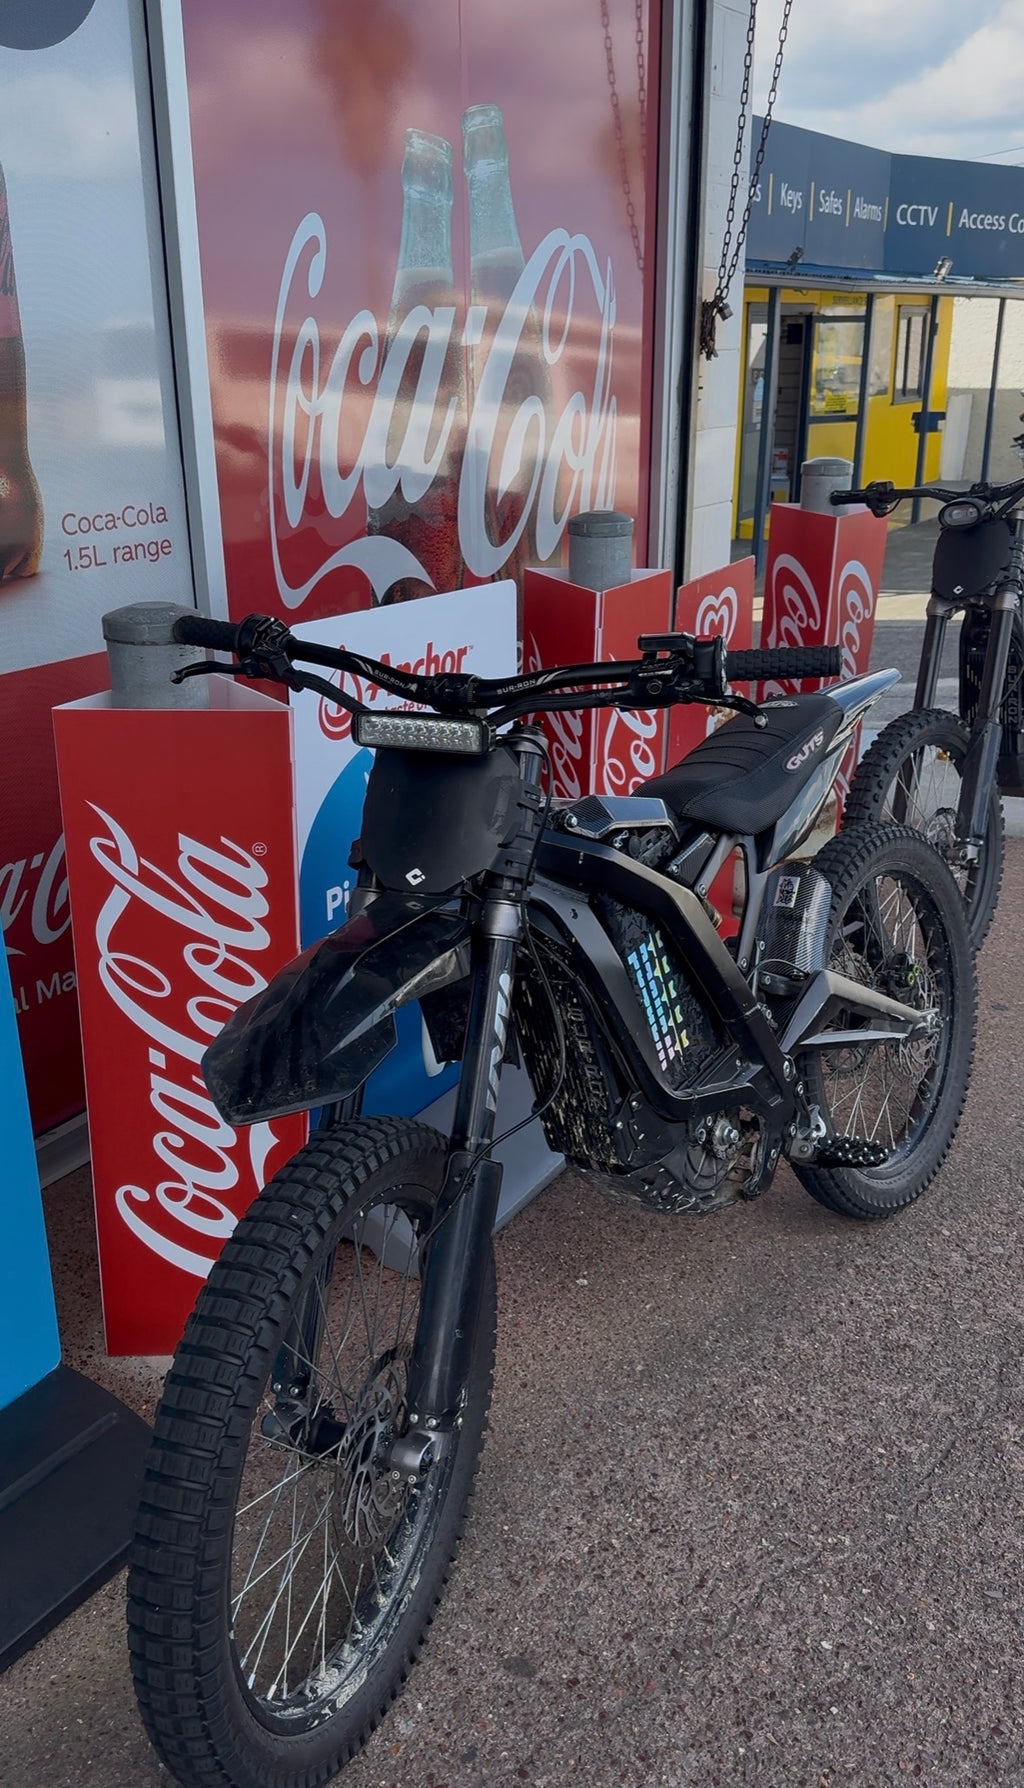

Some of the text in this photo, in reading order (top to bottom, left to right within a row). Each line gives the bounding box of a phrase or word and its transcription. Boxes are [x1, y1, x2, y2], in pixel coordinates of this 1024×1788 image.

[780, 182, 803, 214] Keys
[818, 189, 843, 216] Safes
[853, 196, 882, 222] Alarms
[896, 203, 938, 227] CCTV
[958, 208, 1006, 231] Access
[61, 502, 168, 536] Coca-Cola
[63, 538, 173, 571] 1.5L range
[374, 669, 407, 689] SUR-RON
[496, 678, 536, 695] SUR-RON
[786, 729, 824, 770] GUTS
